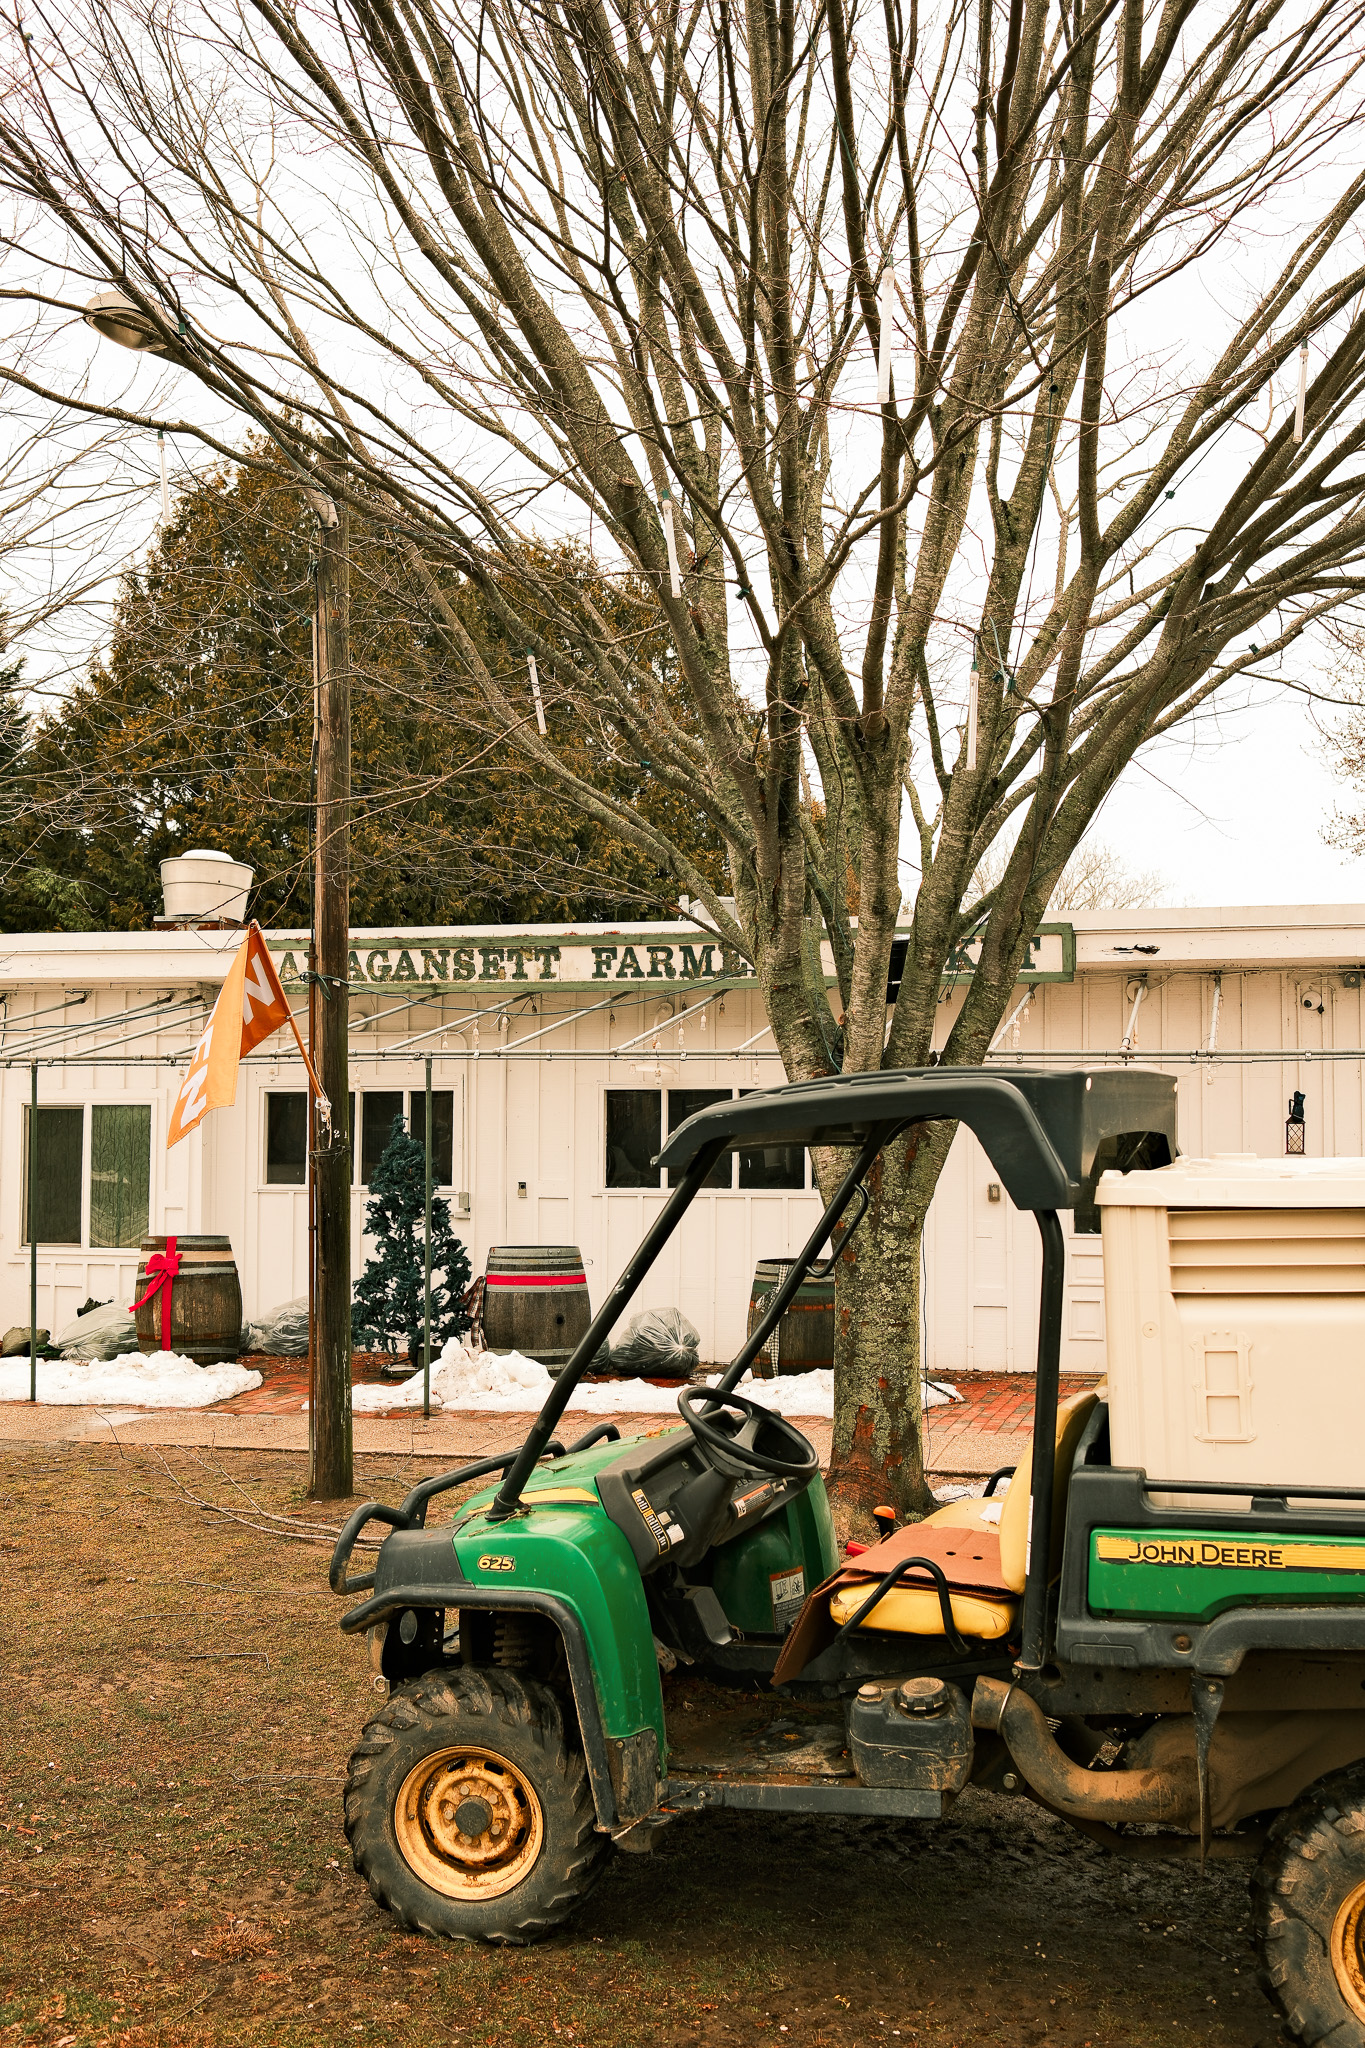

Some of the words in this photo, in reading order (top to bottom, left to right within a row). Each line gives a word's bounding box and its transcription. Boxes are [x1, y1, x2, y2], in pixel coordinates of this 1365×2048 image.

[278, 947, 562, 983] AAGANSETT
[1129, 1543, 1195, 1562] JOHN
[1201, 1543, 1283, 1566] DEERE
